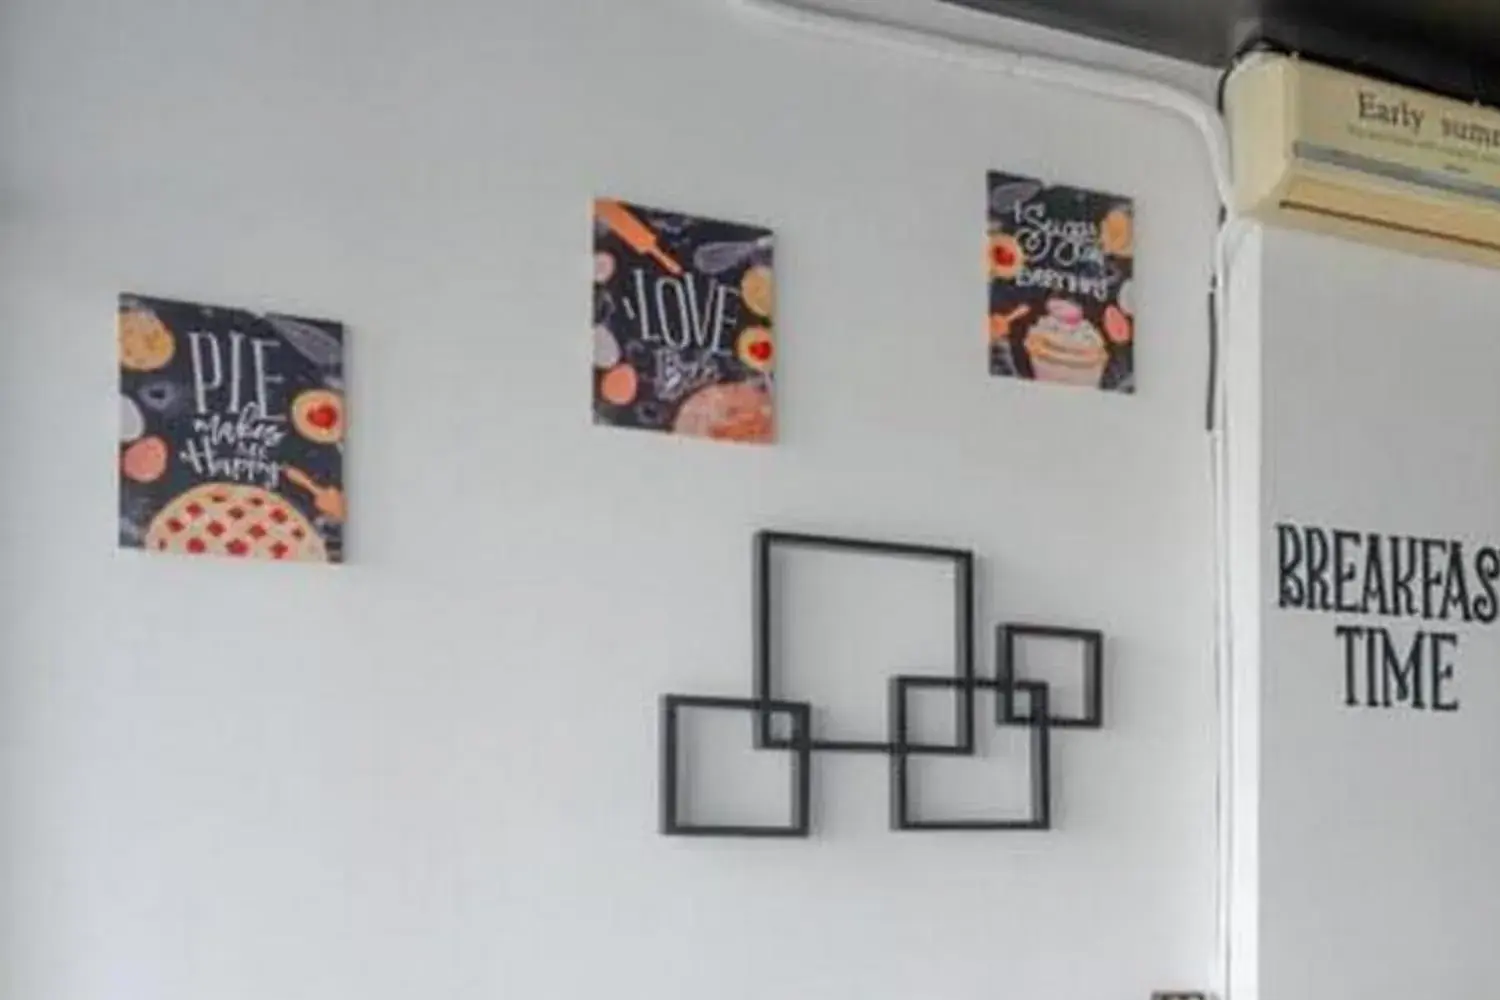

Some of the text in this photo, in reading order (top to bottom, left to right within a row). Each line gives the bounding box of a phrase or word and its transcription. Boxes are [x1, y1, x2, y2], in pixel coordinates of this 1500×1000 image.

[1356, 90, 1426, 133] Early
[633, 269, 741, 354] LOVE
[187, 330, 288, 422] PIE
[1335, 625, 1459, 712] TIME
